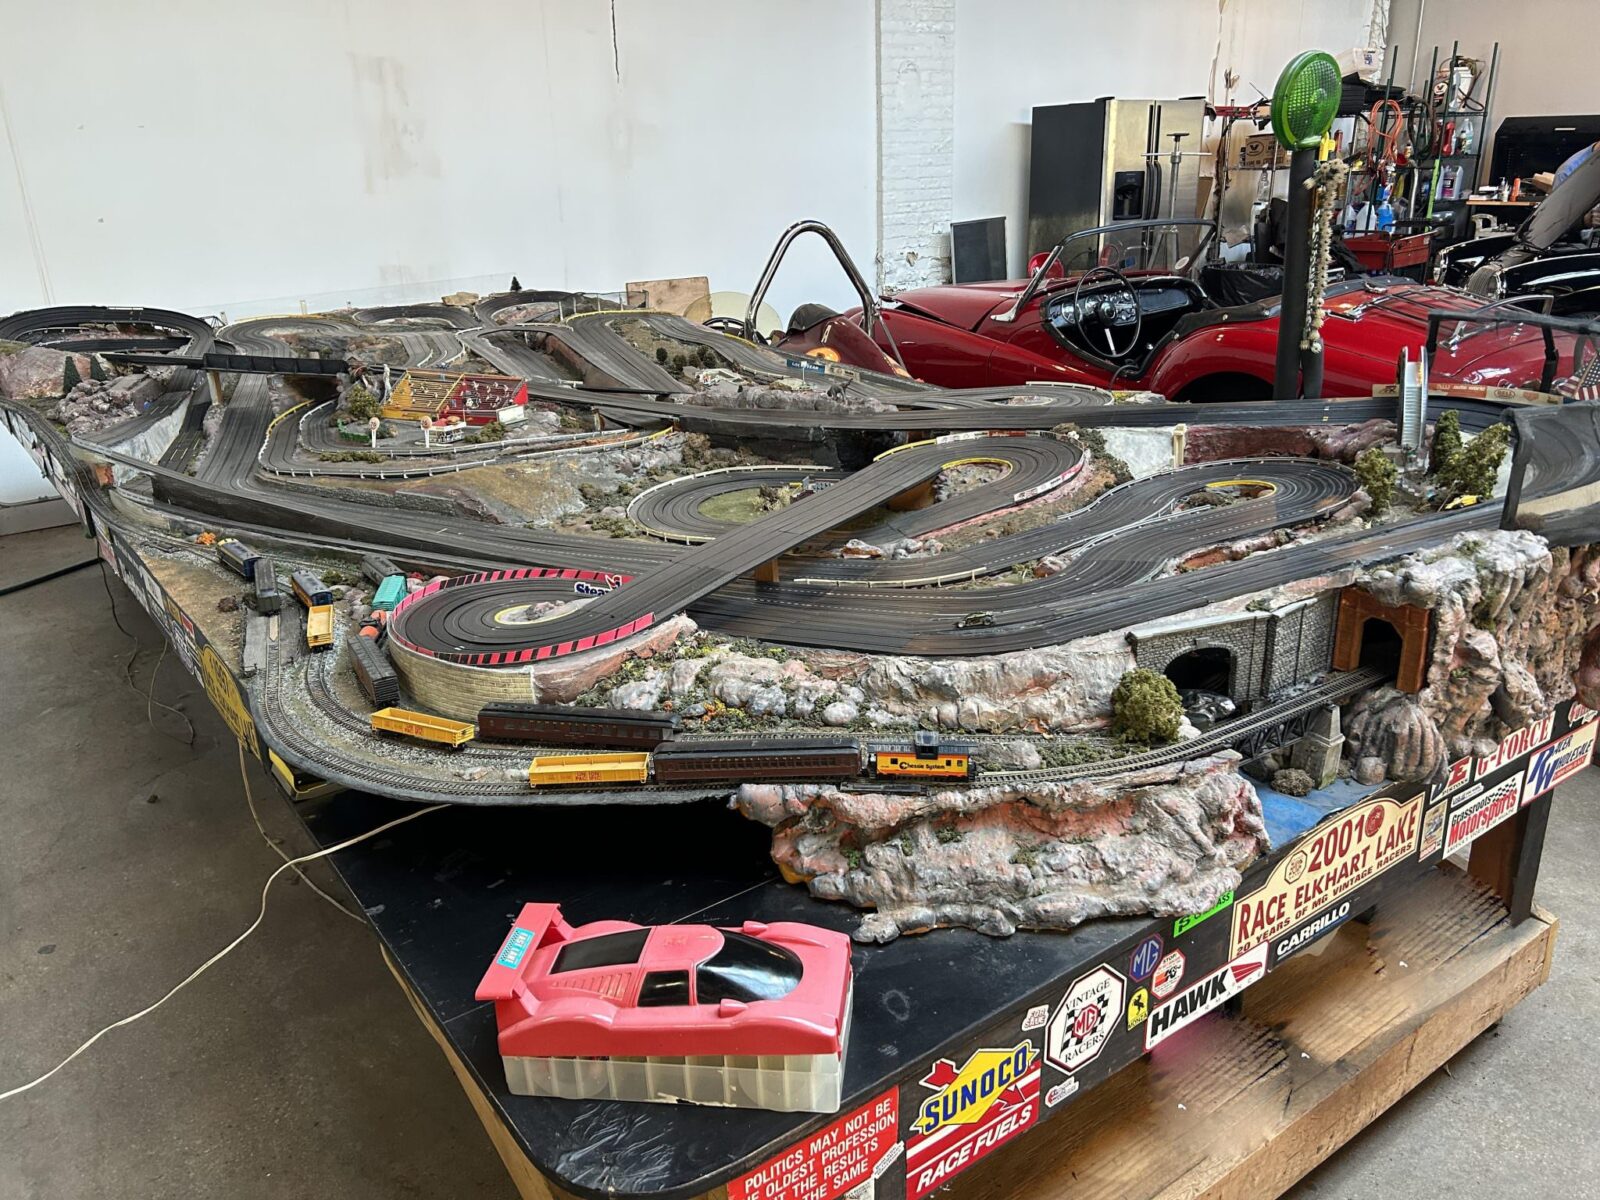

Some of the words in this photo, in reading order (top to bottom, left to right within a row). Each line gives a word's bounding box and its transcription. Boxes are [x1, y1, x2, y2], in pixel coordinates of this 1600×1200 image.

[575, 583, 609, 596] Stea
[899, 761, 925, 770] Chessie
[1448, 789, 1517, 848] Motorsports
[1453, 796, 1491, 826] Grassroots
[1308, 814, 1366, 872] 2001
[1237, 941, 1251, 956] 20
[1256, 918, 1291, 943] YEARS
[1295, 908, 1308, 920] OF
[1312, 894, 1329, 910] MG
[1333, 868, 1373, 896] VINTAGE
[1377, 842, 1412, 867] RACERS
[1238, 893, 1287, 944] RACE
[1294, 845, 1370, 909] ELKHART
[1375, 802, 1417, 859] LAKE
[1277, 902, 1350, 955] CARRILLO
[1133, 940, 1159, 976] MG
[1066, 978, 1111, 1011] VINTAGE
[1075, 1008, 1097, 1036] MG
[1151, 968, 1229, 1038] HAWK
[1065, 1032, 1105, 1063] RACERS
[925, 1046, 1027, 1132] SUNOCO
[744, 1149, 803, 1194] POLITICS
[809, 1128, 840, 1155] MAY
[845, 1110, 870, 1134] NOT
[875, 1098, 891, 1117] BE
[765, 1159, 815, 1198] OLDEST
[821, 1112, 896, 1164] PROFESSION
[792, 1173, 818, 1198] THE
[824, 1137, 879, 1180] RESULTS
[916, 1142, 973, 1192] RACE
[973, 1104, 1033, 1156] FUELS
[802, 1183, 828, 1200] THE
[833, 1159, 869, 1190] SAME
